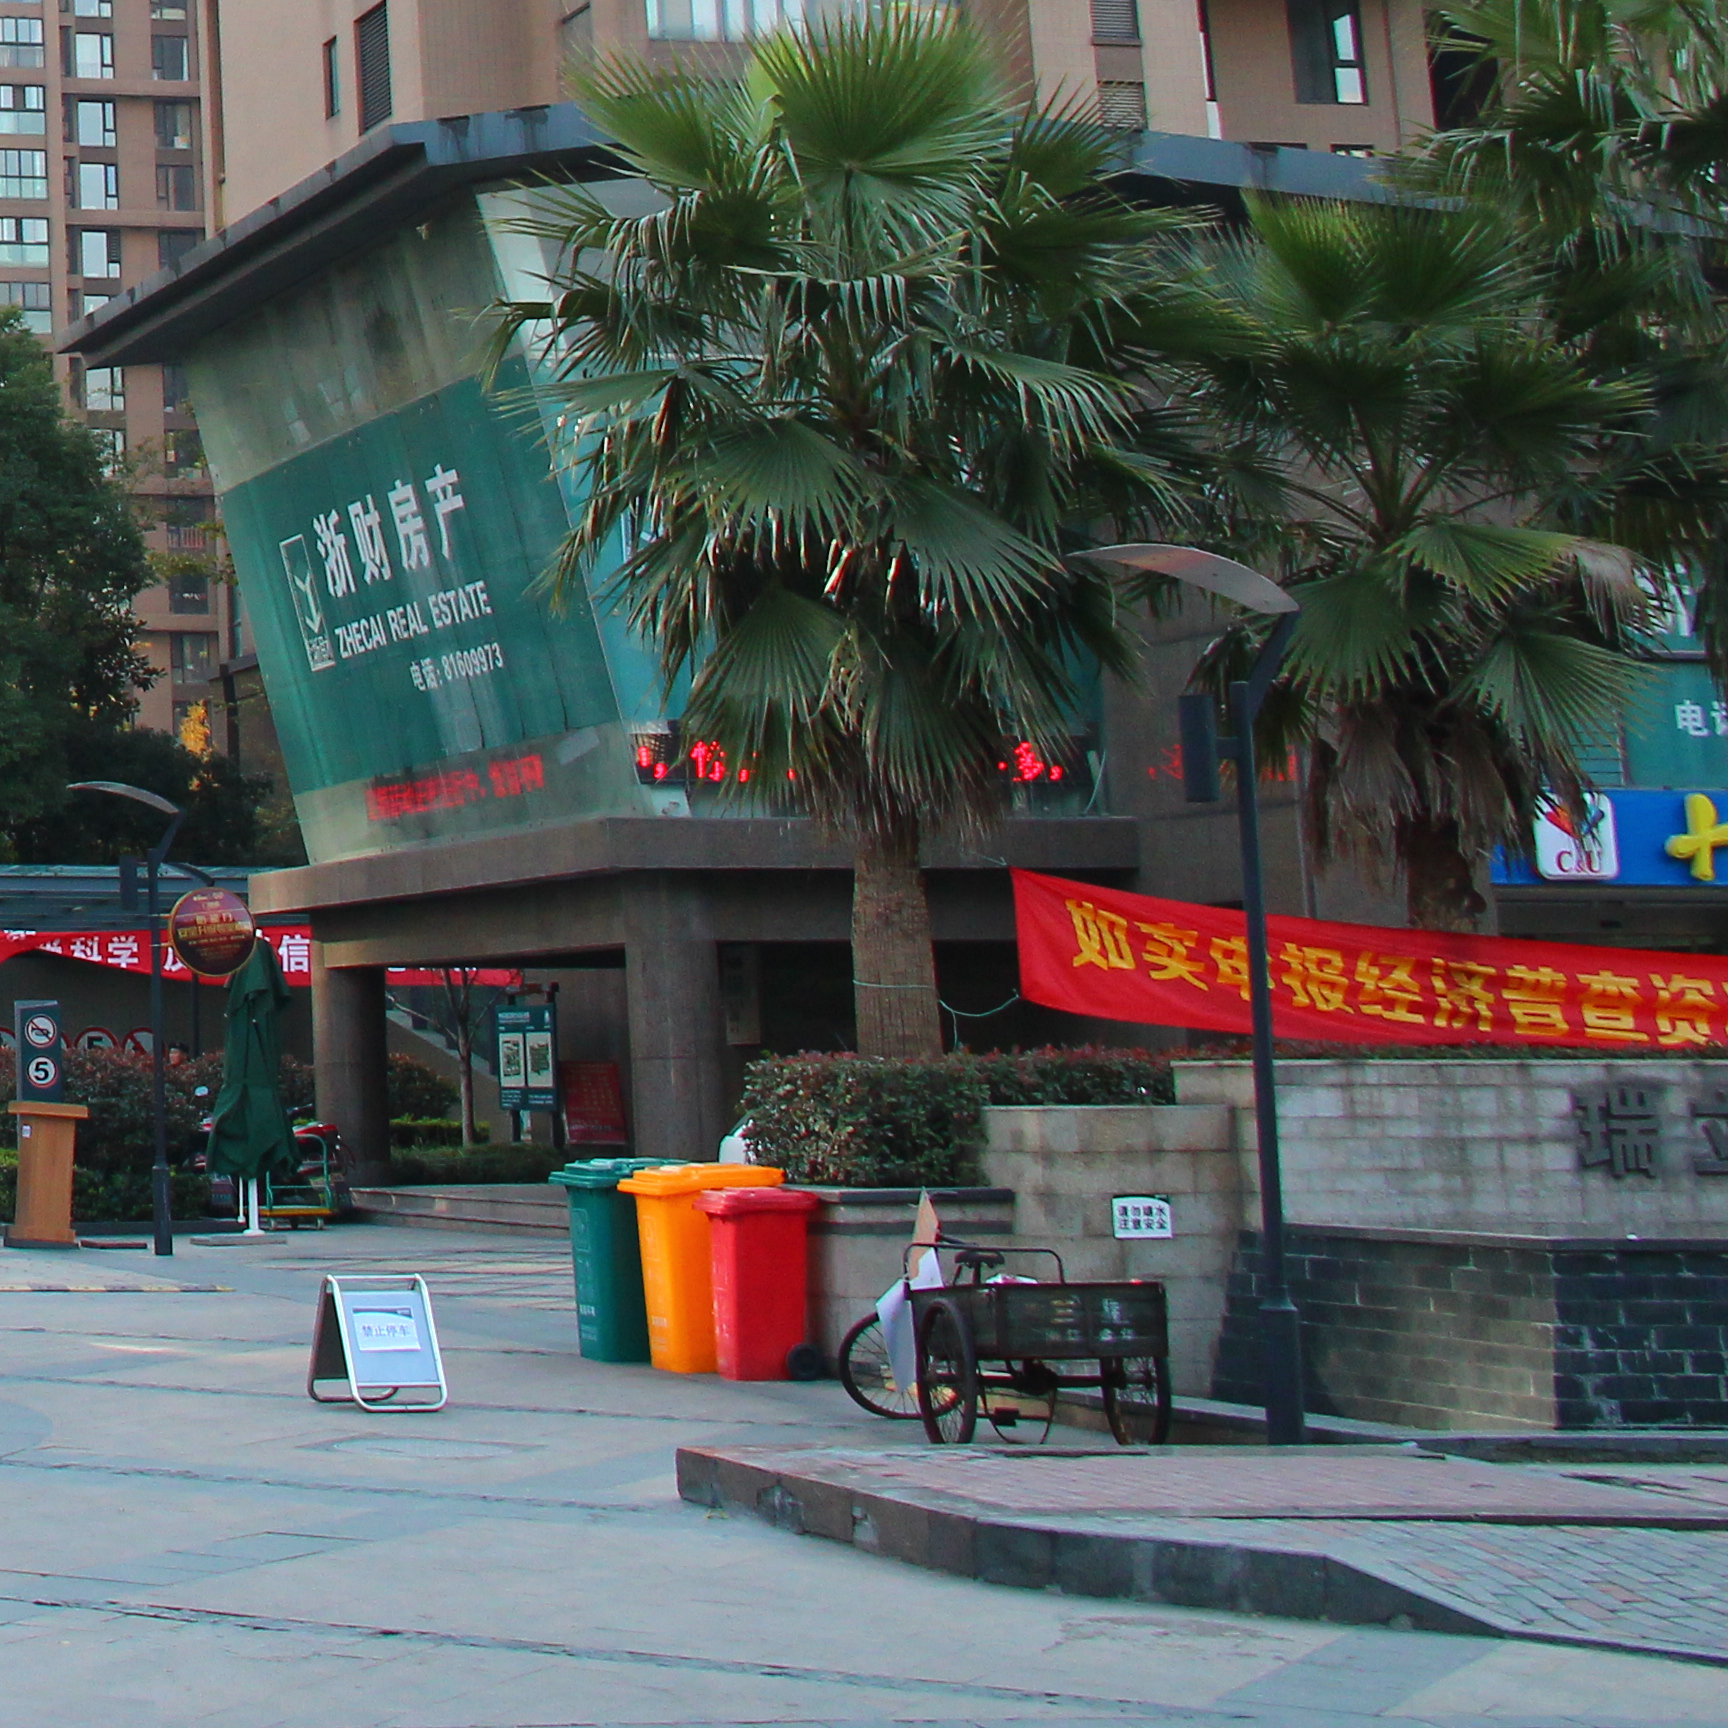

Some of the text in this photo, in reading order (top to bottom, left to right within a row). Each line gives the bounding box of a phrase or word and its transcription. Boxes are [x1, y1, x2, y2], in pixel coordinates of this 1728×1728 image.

[311, 463, 465, 599] 浙财房产
[334, 614, 388, 660] ZHECAI
[386, 601, 430, 642] REAL
[428, 579, 494, 629] ESTATE
[35, 1061, 50, 1082] 5
